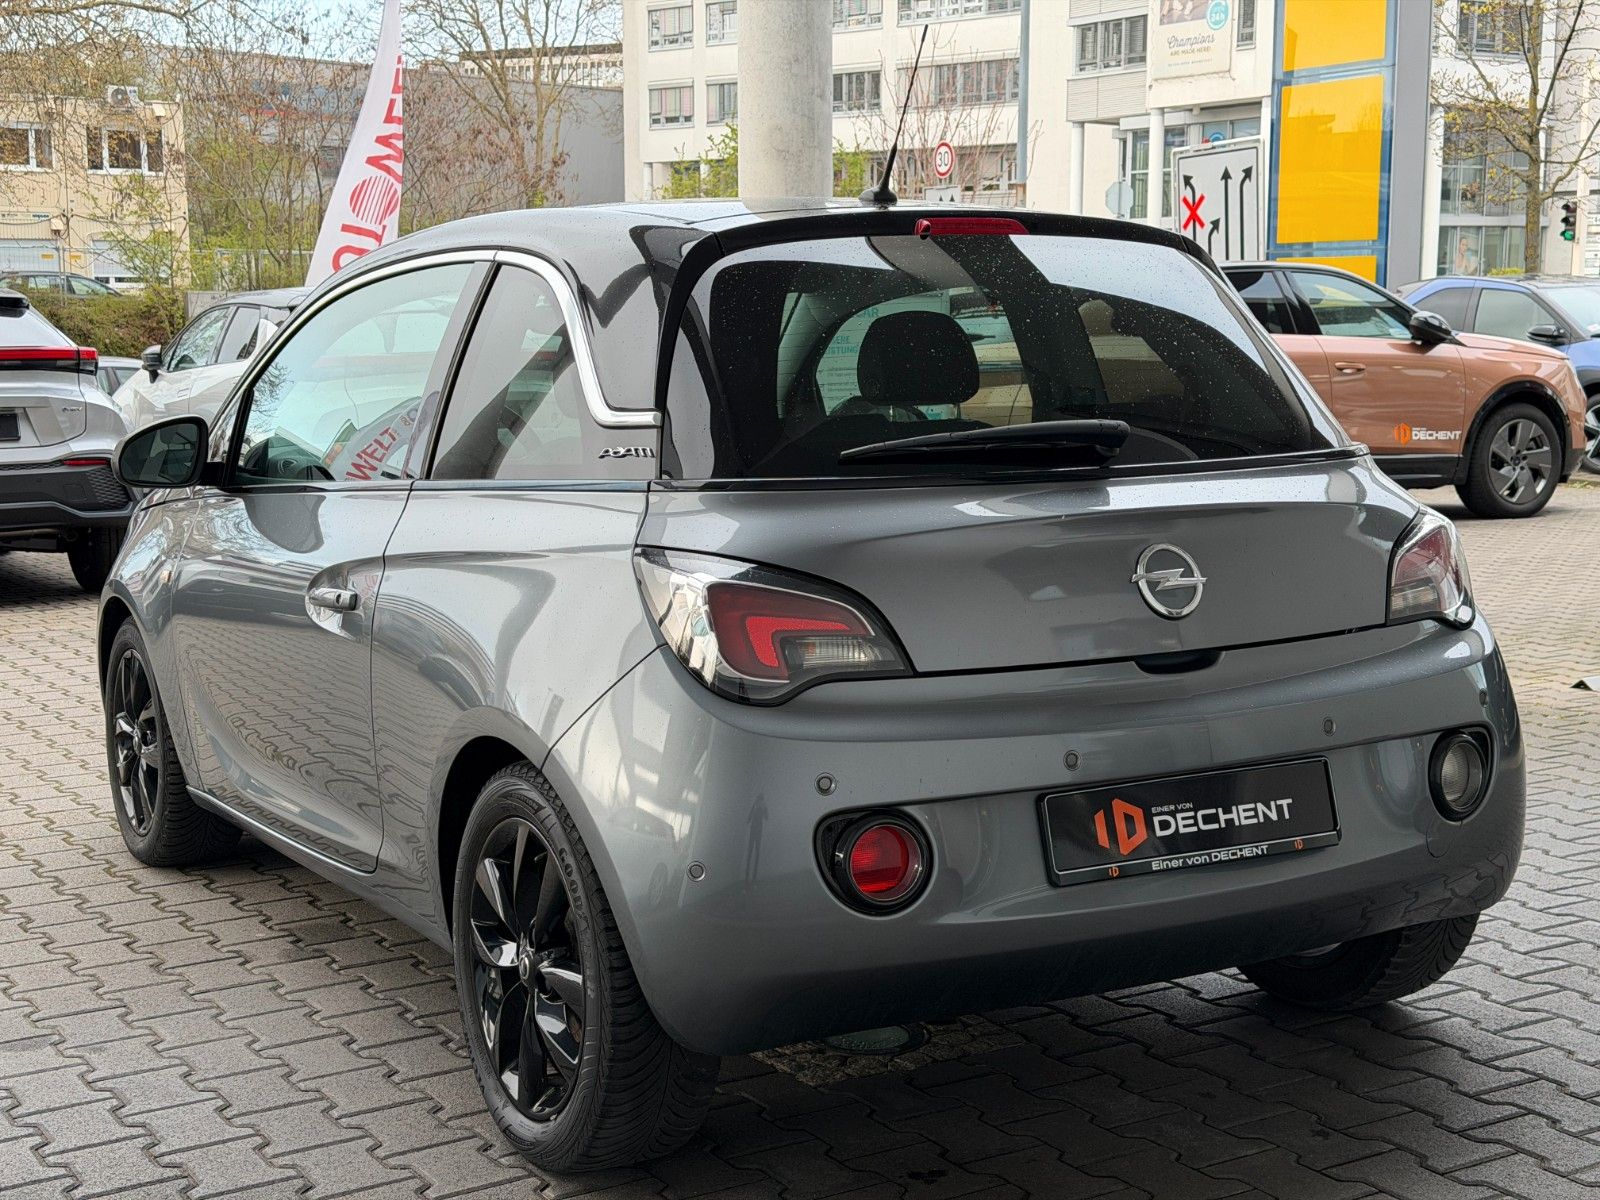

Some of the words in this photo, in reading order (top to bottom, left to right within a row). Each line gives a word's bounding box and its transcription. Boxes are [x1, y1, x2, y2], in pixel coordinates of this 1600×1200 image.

[1167, 33, 1215, 48] Champions
[937, 150, 950, 168] 30
[1412, 431, 1461, 440] DECHENT
[1151, 805, 1175, 813] EINER
[1176, 802, 1193, 811] VON
[1152, 798, 1293, 837] DECHENT
[1151, 858, 1183, 871] Einer
[1186, 855, 1210, 865] von
[1211, 845, 1269, 862] DECHENT
